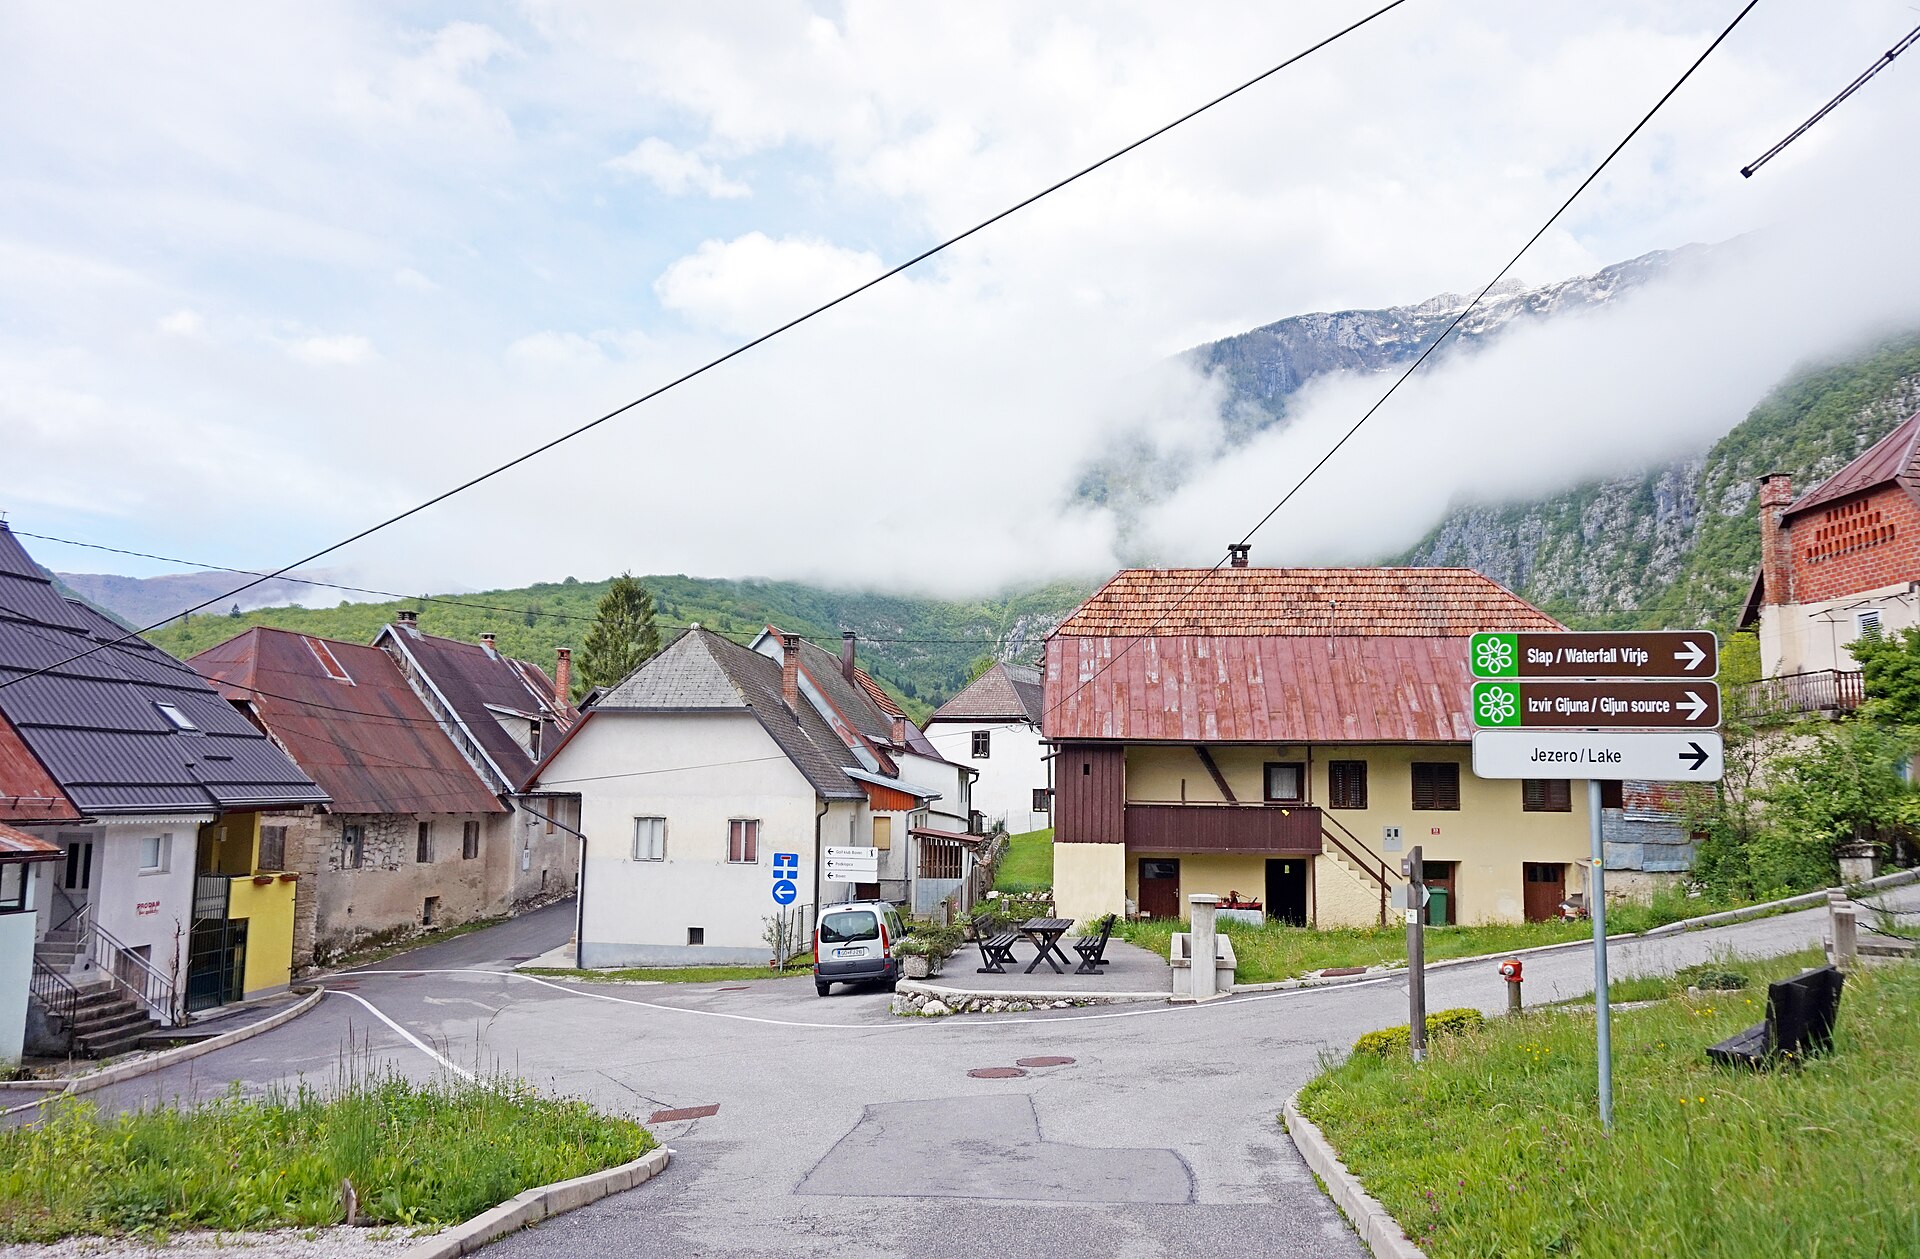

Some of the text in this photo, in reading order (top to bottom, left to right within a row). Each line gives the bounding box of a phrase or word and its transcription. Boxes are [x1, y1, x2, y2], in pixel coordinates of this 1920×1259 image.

[1527, 648, 1648, 666] Slap / Waterfall Virje
[1528, 697, 1670, 715] Izvir Gljuna / Gljun source
[1531, 748, 1577, 763] Jezero
[1588, 748, 1621, 763] Lake
